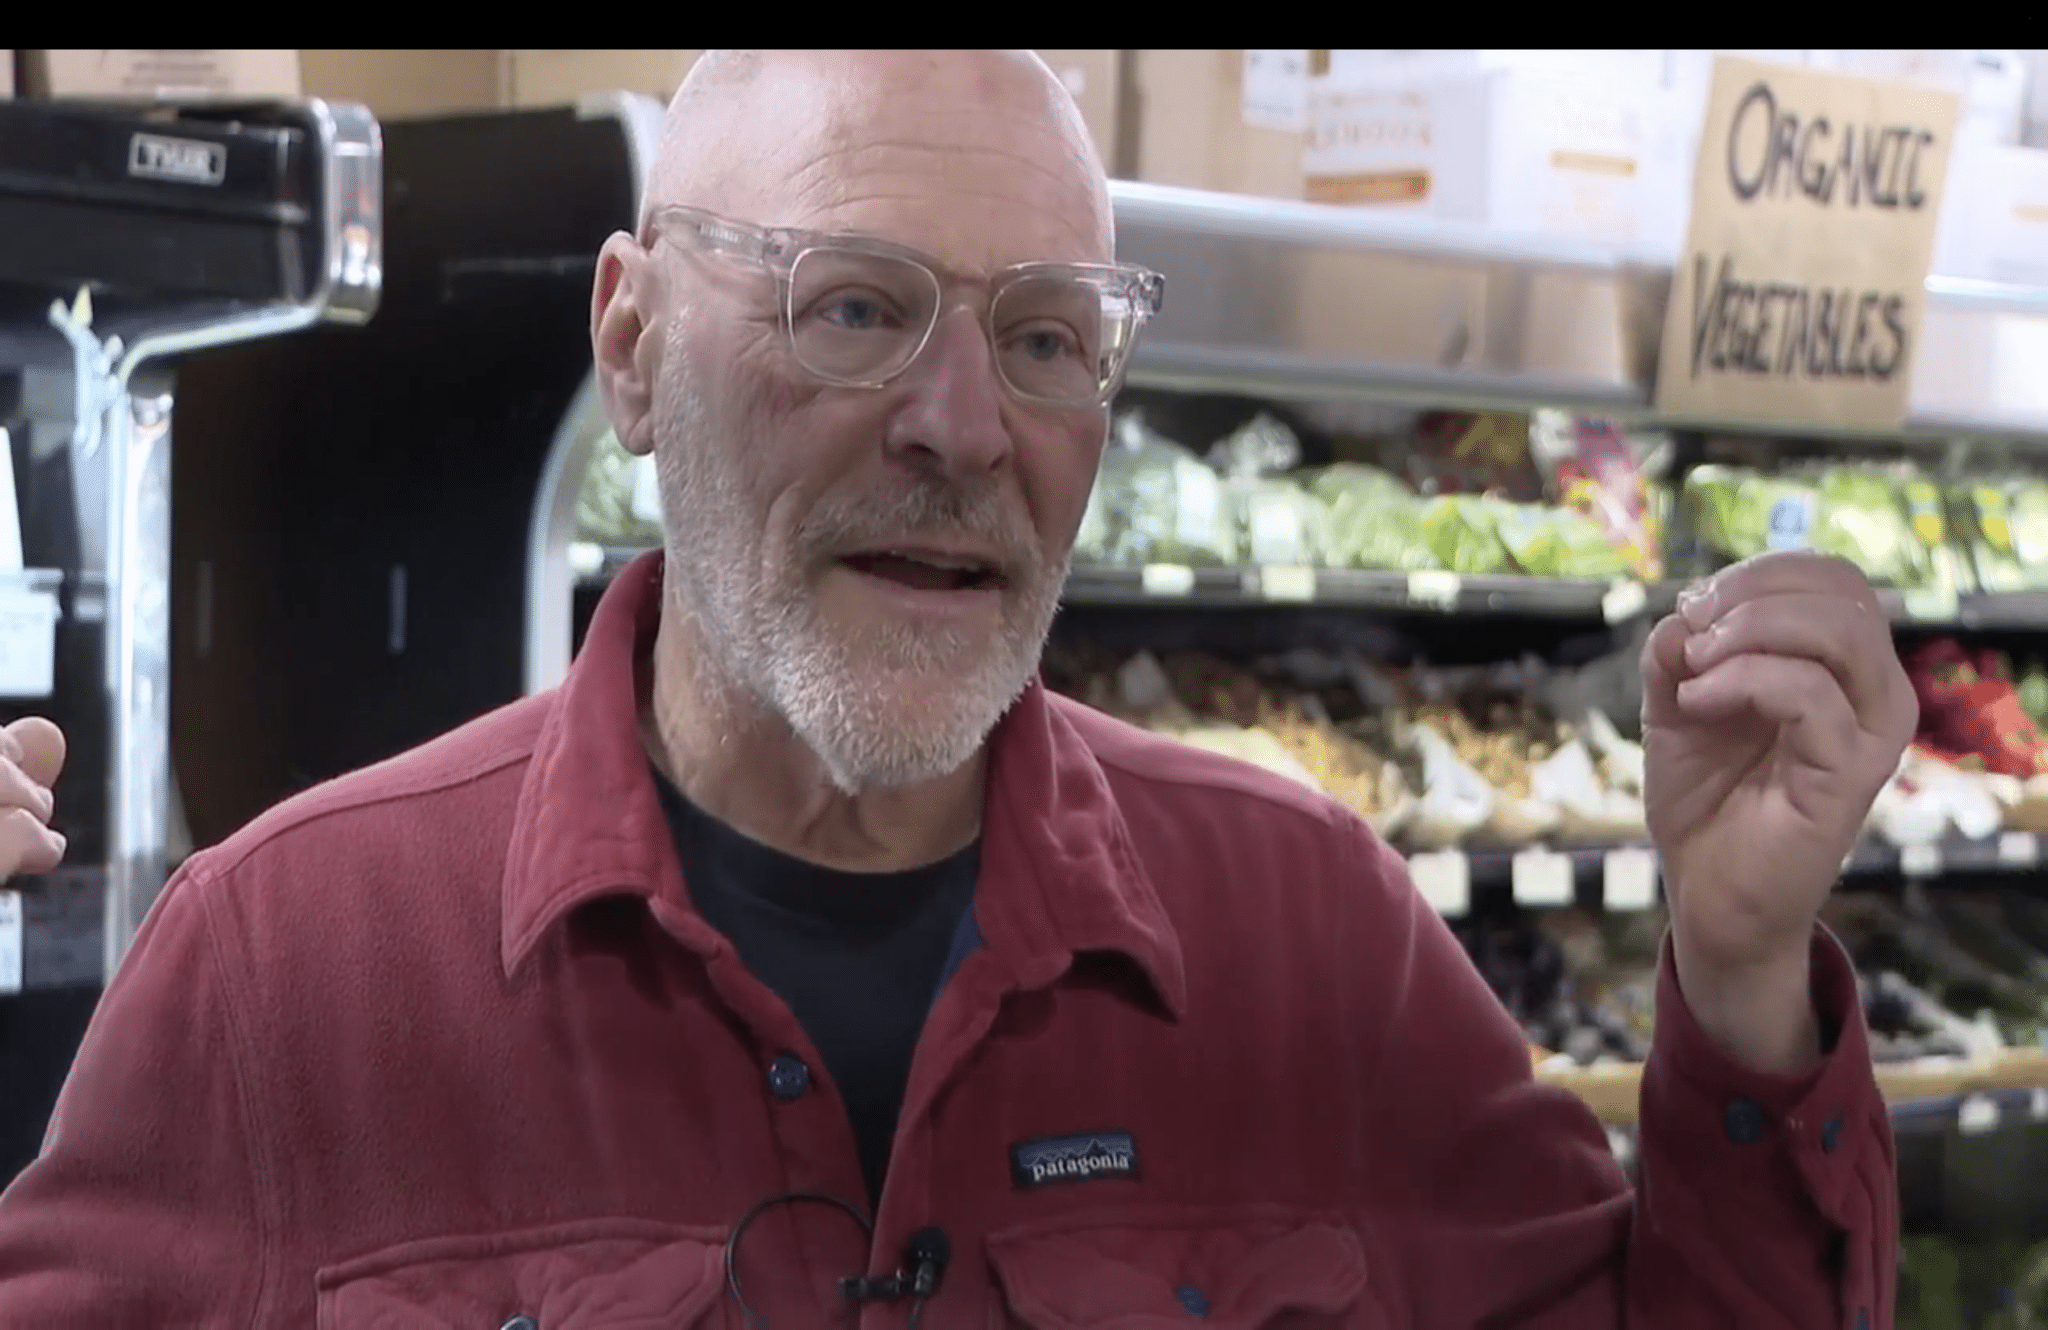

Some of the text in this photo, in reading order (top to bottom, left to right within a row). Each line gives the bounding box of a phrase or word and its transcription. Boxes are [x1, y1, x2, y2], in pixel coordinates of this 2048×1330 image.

[1727, 81, 1933, 211] ORGANIC
[1689, 251, 1910, 382] VEGETABLES
[1032, 1153, 1130, 1182] patagonia
